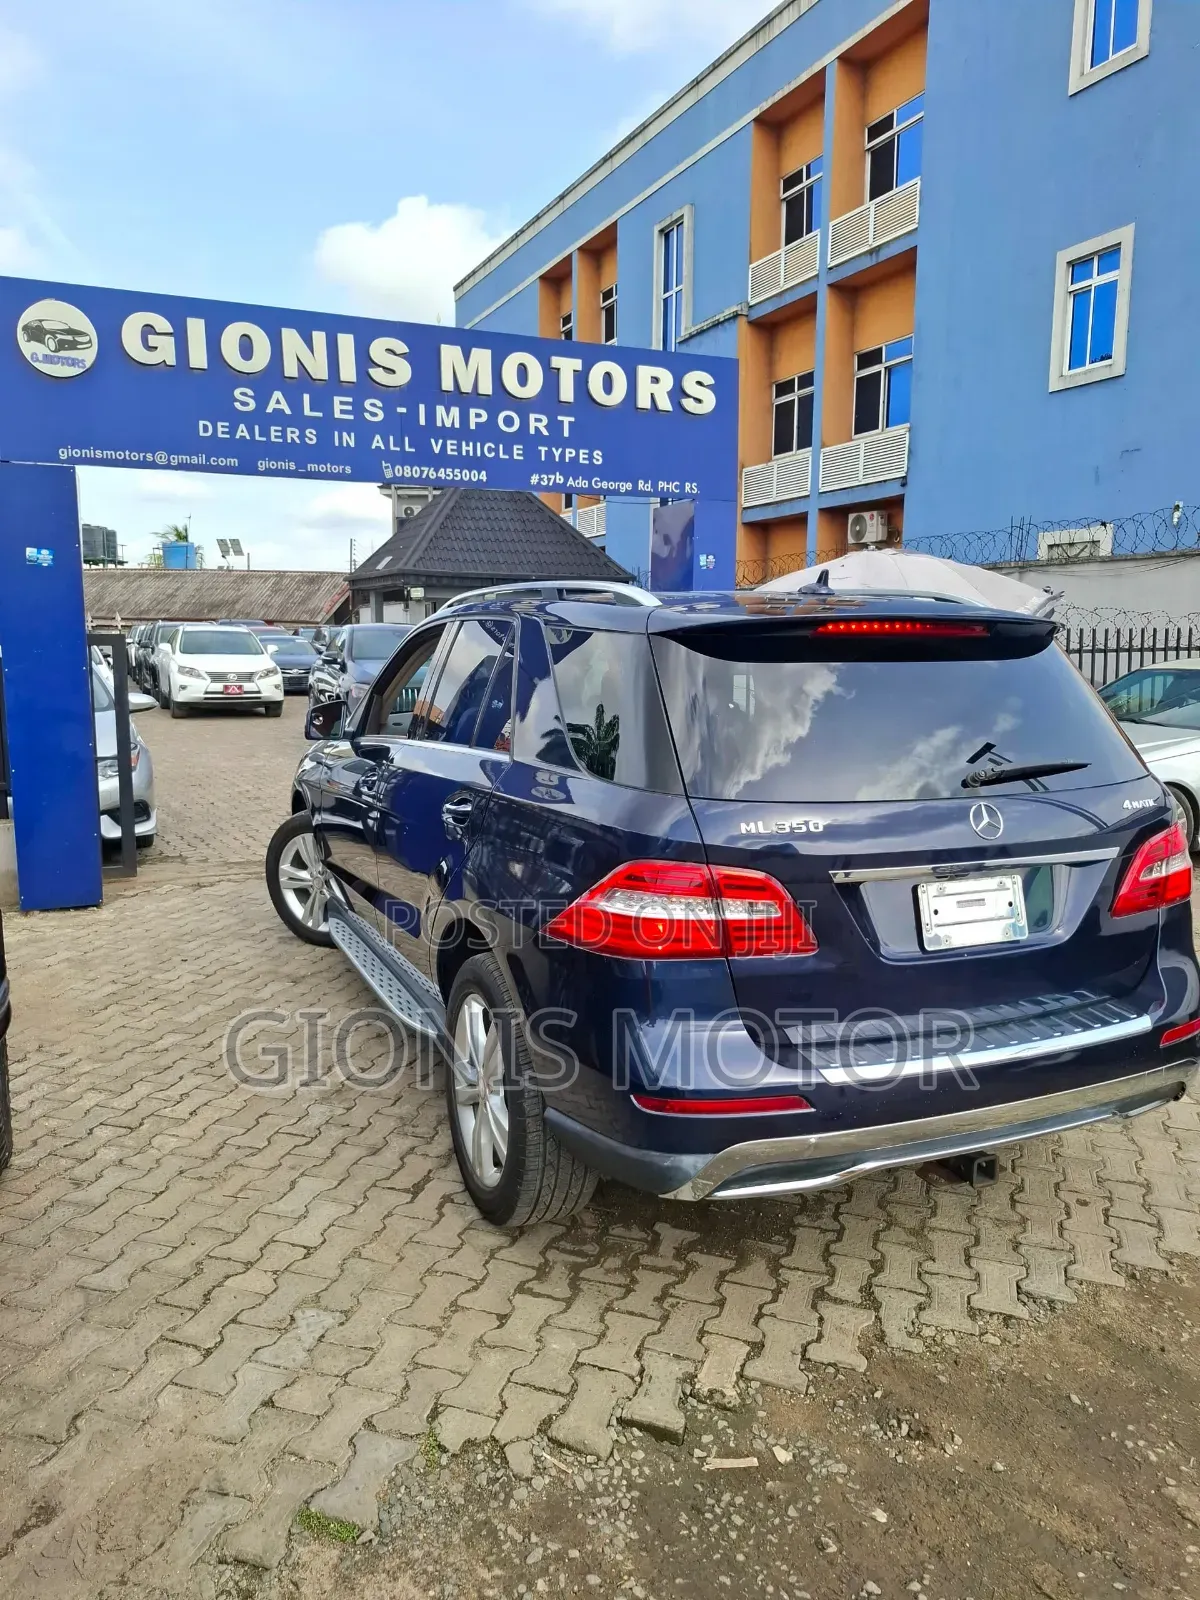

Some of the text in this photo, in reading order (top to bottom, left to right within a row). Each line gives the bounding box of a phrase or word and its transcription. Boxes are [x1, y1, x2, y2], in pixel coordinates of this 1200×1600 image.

[121, 311, 717, 416] GIONIS MOTORS
[199, 420, 604, 465] DEALERS IN ALL VEHICLE TYPES
[58, 446, 239, 467] gionismotors@gmail.com
[394, 465, 488, 482] 08076455004
[530, 472, 564, 486] #37b
[567, 476, 589, 489] Ada
[592, 477, 633, 493] George
[658, 481, 680, 493] PHC
[740, 820, 824, 834] ML 350
